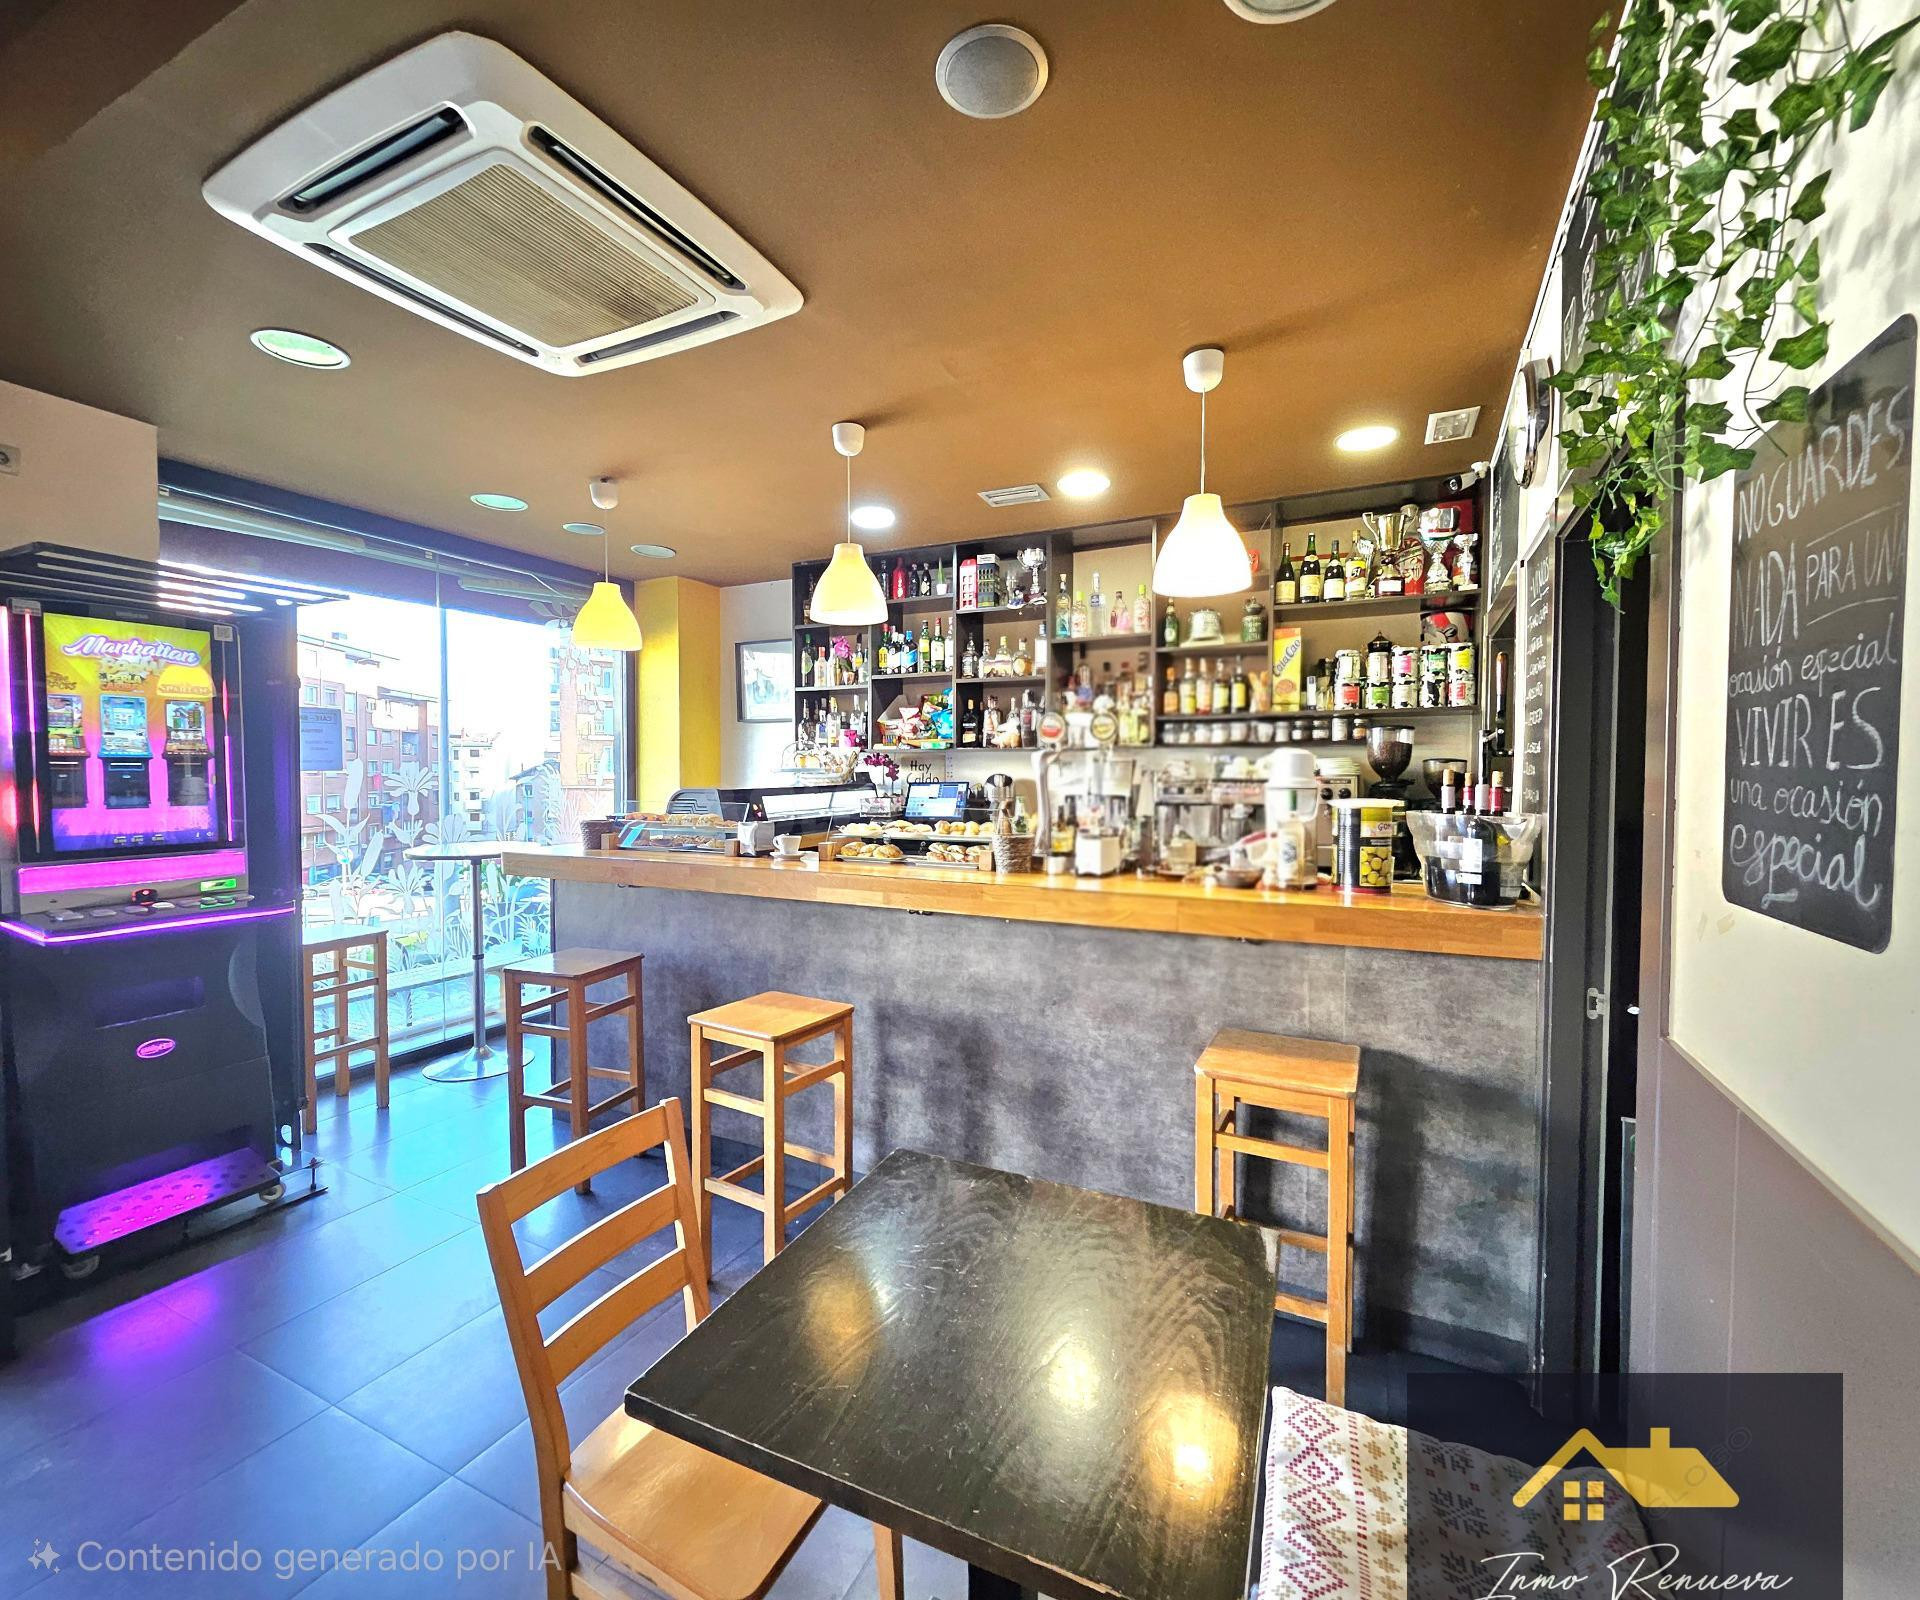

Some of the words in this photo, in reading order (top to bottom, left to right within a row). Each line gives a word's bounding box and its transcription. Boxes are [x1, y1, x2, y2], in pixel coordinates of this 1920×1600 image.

[1734, 540, 1799, 650] NADA
[1805, 541, 1857, 606] PARA
[63, 635, 201, 667] Manhattan
[1728, 645, 1793, 699] ocasión
[1801, 612, 1898, 697] especial
[910, 760, 932, 774] Hay
[1735, 693, 1813, 768] VIVIR
[1826, 687, 1884, 770] ES
[1730, 778, 1767, 811] una
[1774, 779, 1883, 837] ocasión
[1729, 824, 1883, 909] especial
